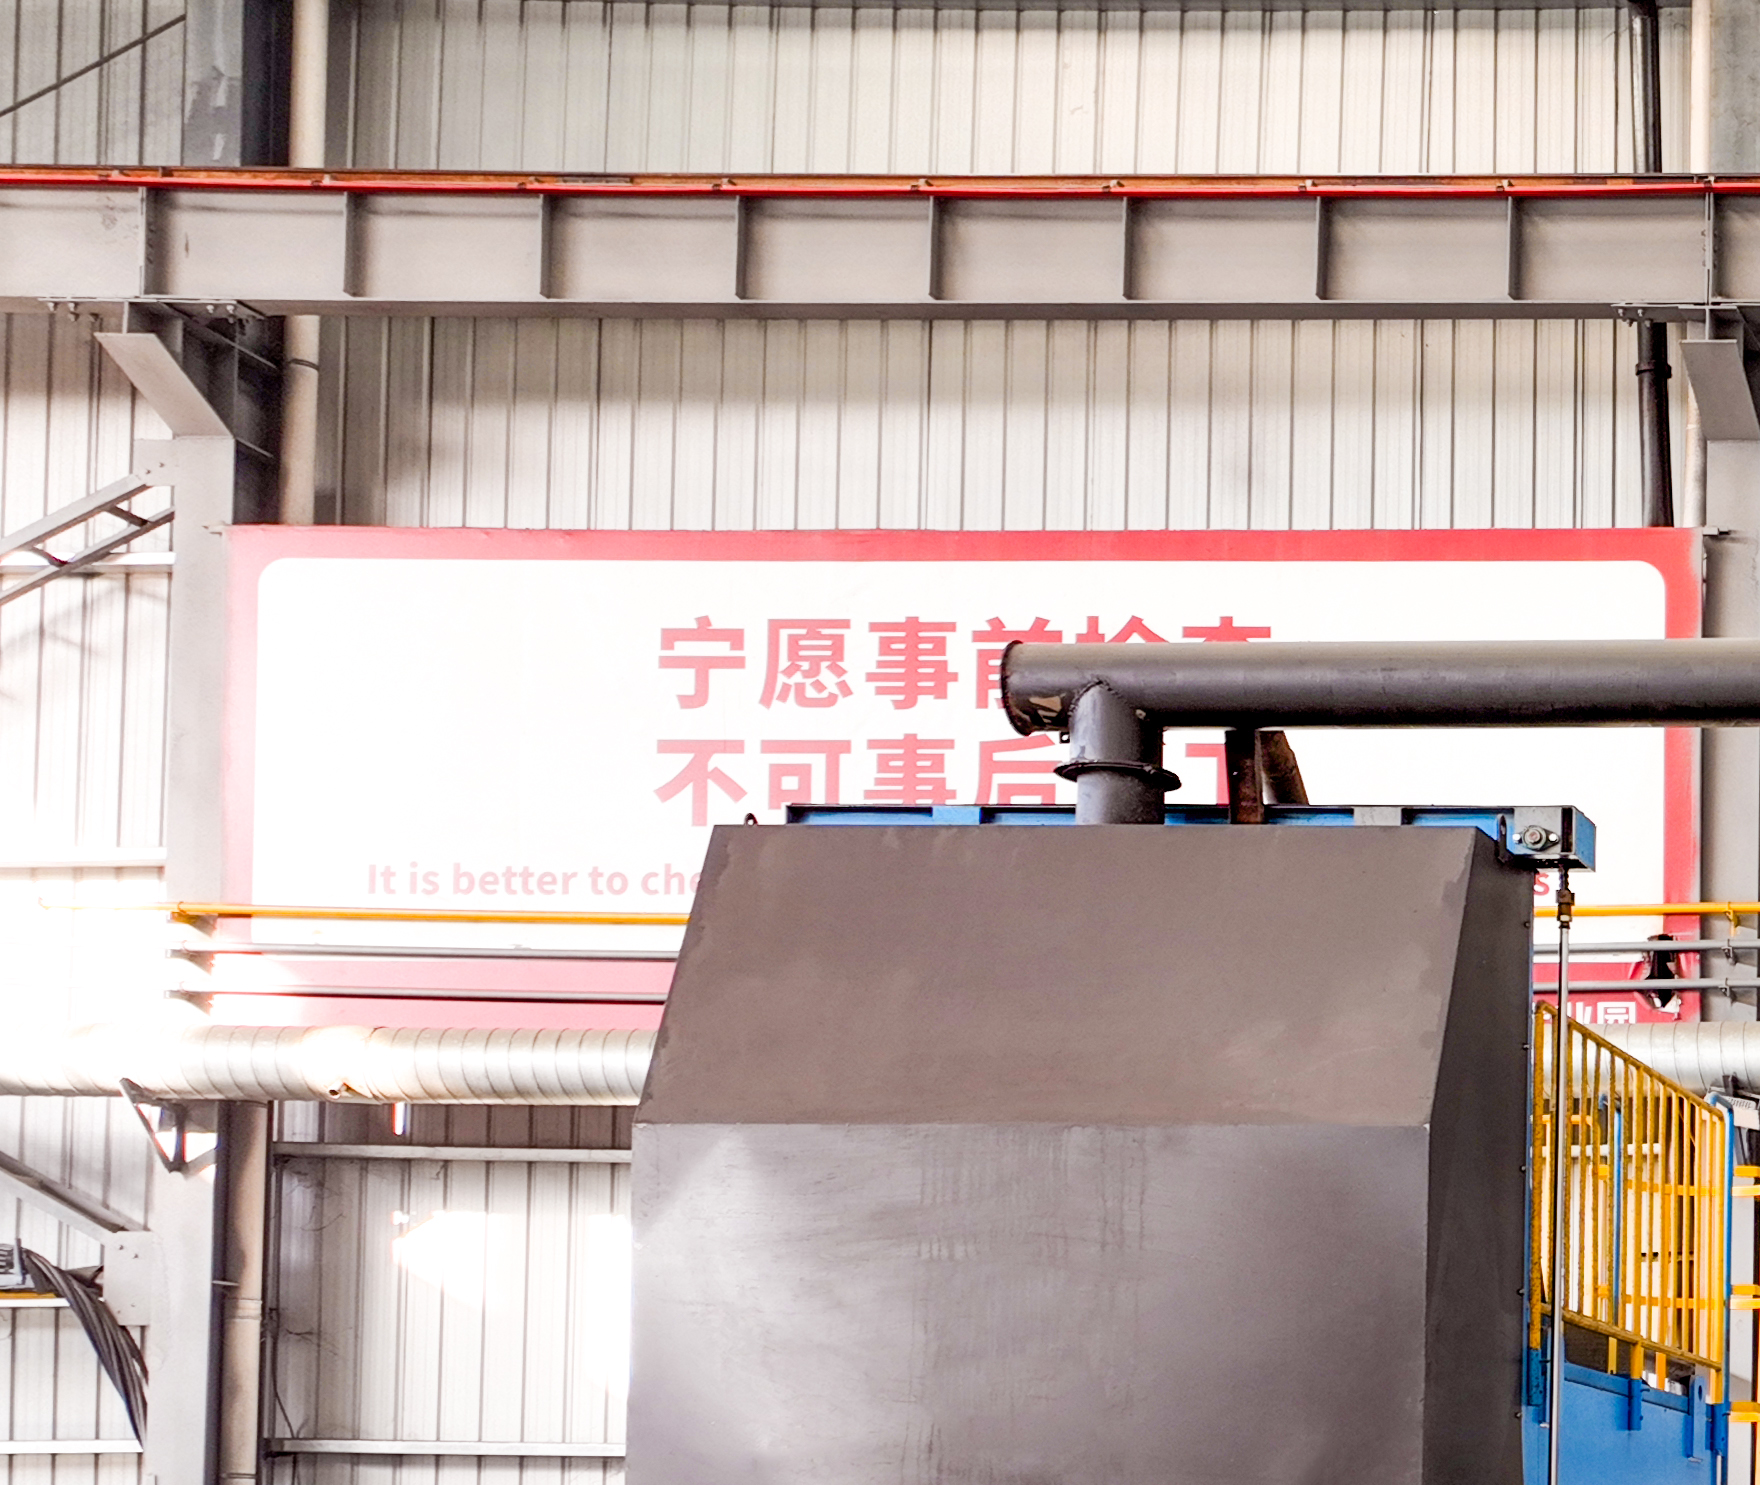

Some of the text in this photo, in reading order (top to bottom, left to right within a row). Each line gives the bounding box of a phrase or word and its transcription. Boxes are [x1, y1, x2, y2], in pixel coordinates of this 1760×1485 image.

[657, 614, 1272, 710] 宁愿事
[654, 732, 1229, 827] 不可事后
[367, 863, 397, 895] It
[408, 860, 440, 896] is
[452, 861, 579, 896] better
[587, 865, 629, 896] to
